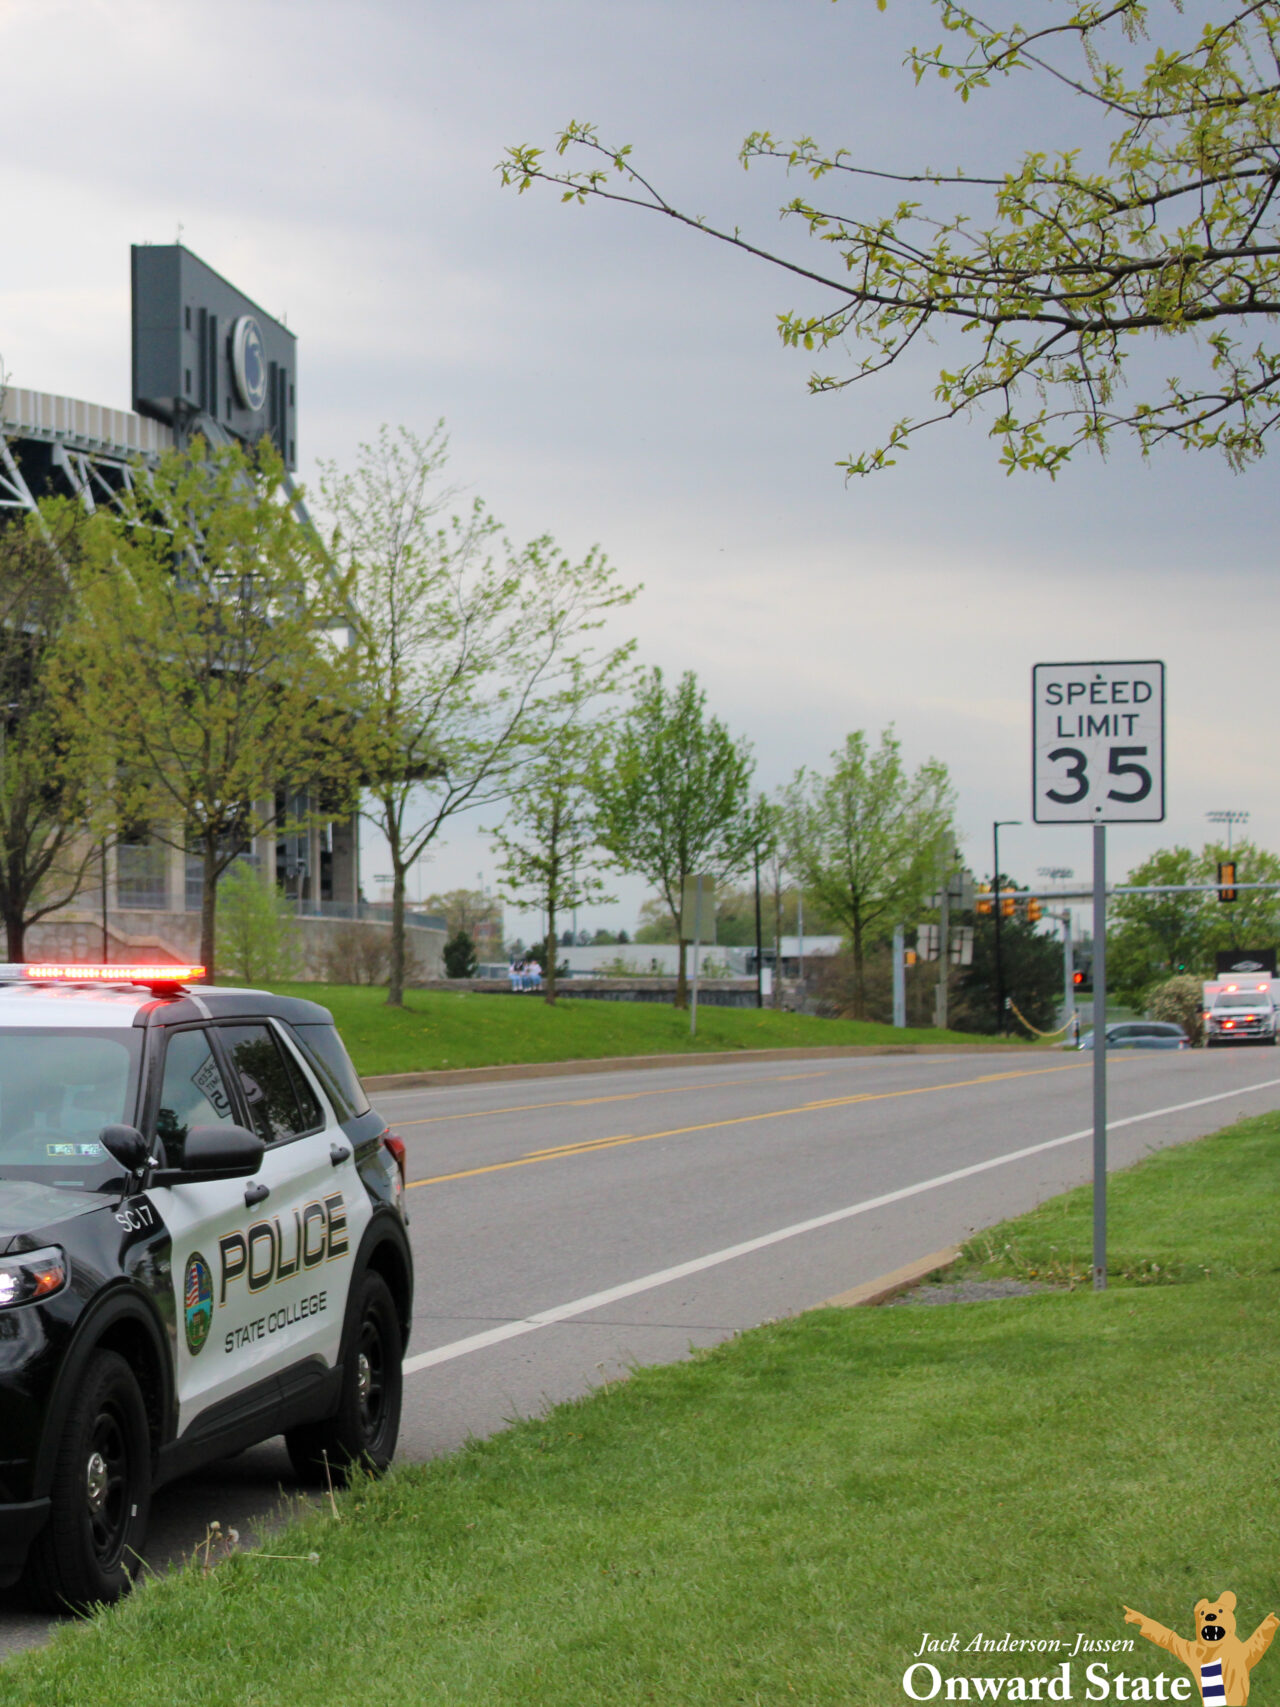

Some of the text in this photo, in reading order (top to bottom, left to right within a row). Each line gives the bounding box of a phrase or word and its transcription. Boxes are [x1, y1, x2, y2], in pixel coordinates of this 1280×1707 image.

[1045, 680, 1153, 706] SPEED
[1057, 714, 1140, 738] LIMIT
[1045, 746, 1153, 805] 35
[115, 1205, 154, 1233] SC17
[218, 1190, 350, 1308] POLICE
[224, 1291, 328, 1354] STATE COLLEGE
